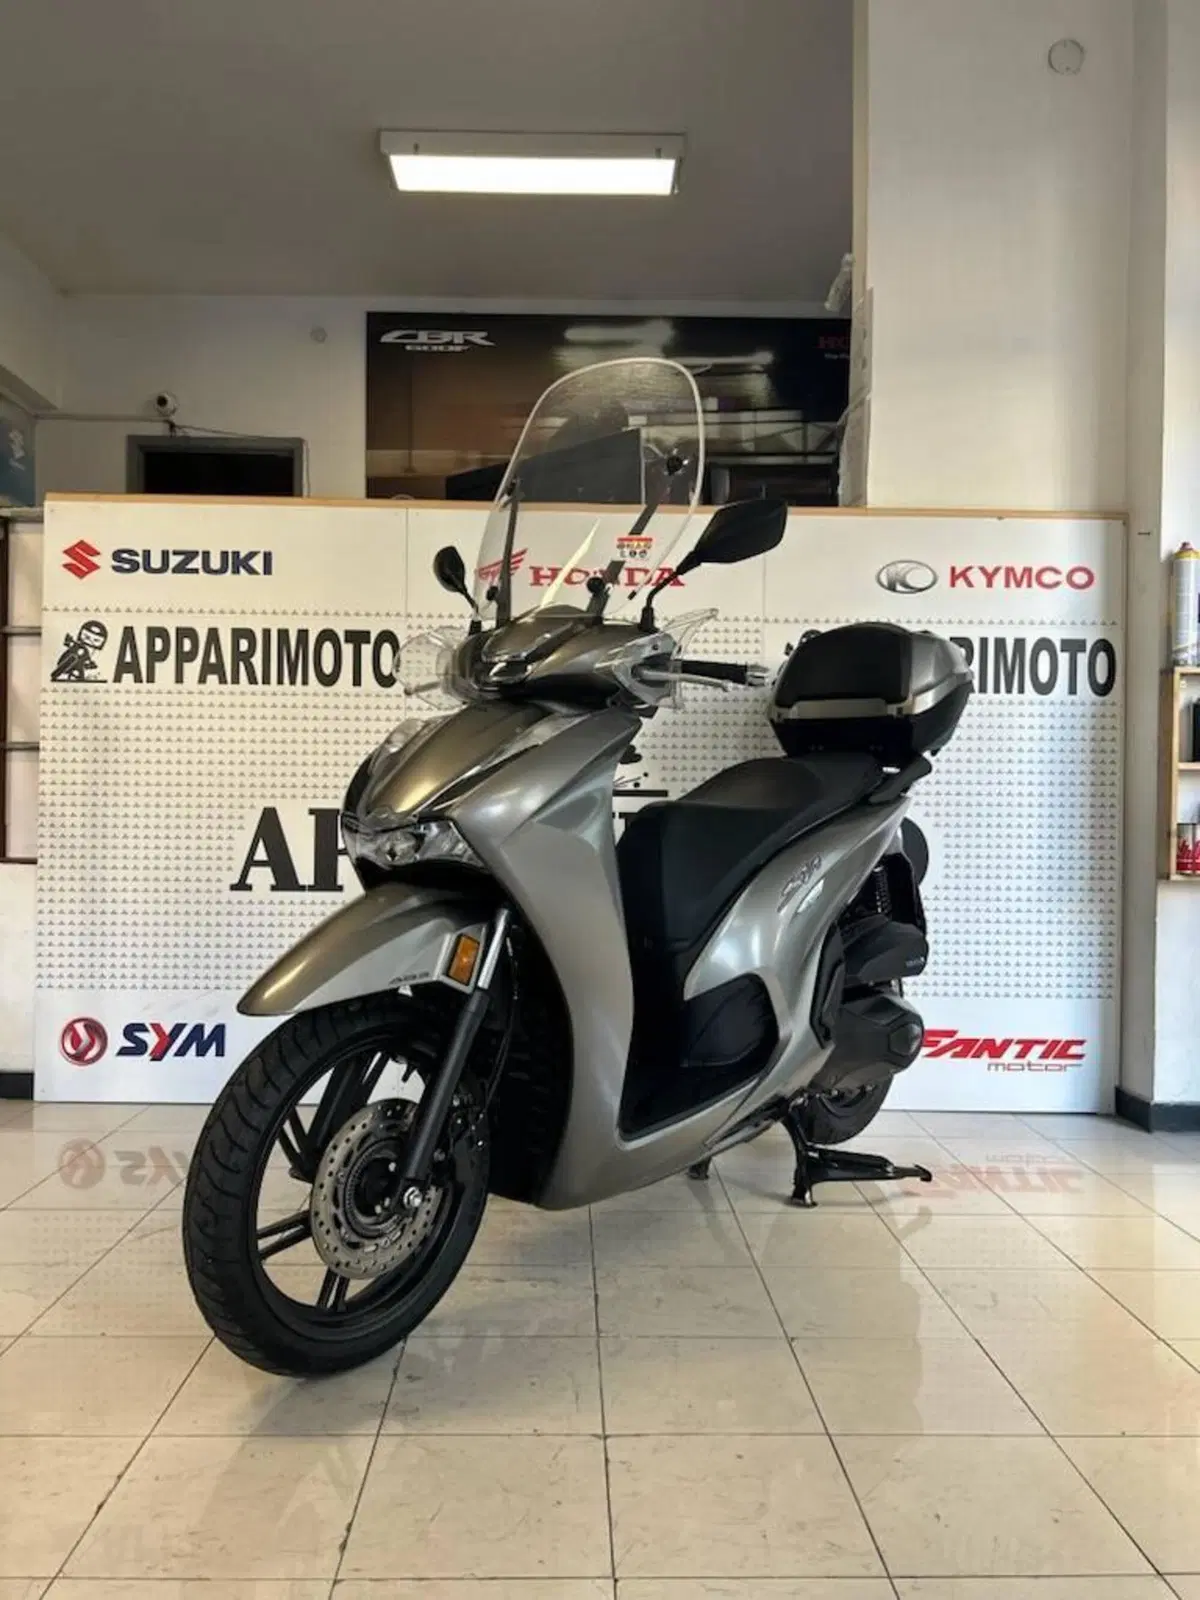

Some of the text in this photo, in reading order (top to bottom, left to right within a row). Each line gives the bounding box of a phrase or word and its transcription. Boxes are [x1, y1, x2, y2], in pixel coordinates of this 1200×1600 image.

[380, 329, 495, 346] CBR
[111, 548, 273, 576] SUZUKI
[949, 565, 1095, 589] KYMCO
[112, 625, 400, 688] APPARIMOTO
[116, 1022, 226, 1062] SYM
[921, 1029, 1087, 1060] FANTIC
[987, 1061, 1083, 1073] motor
